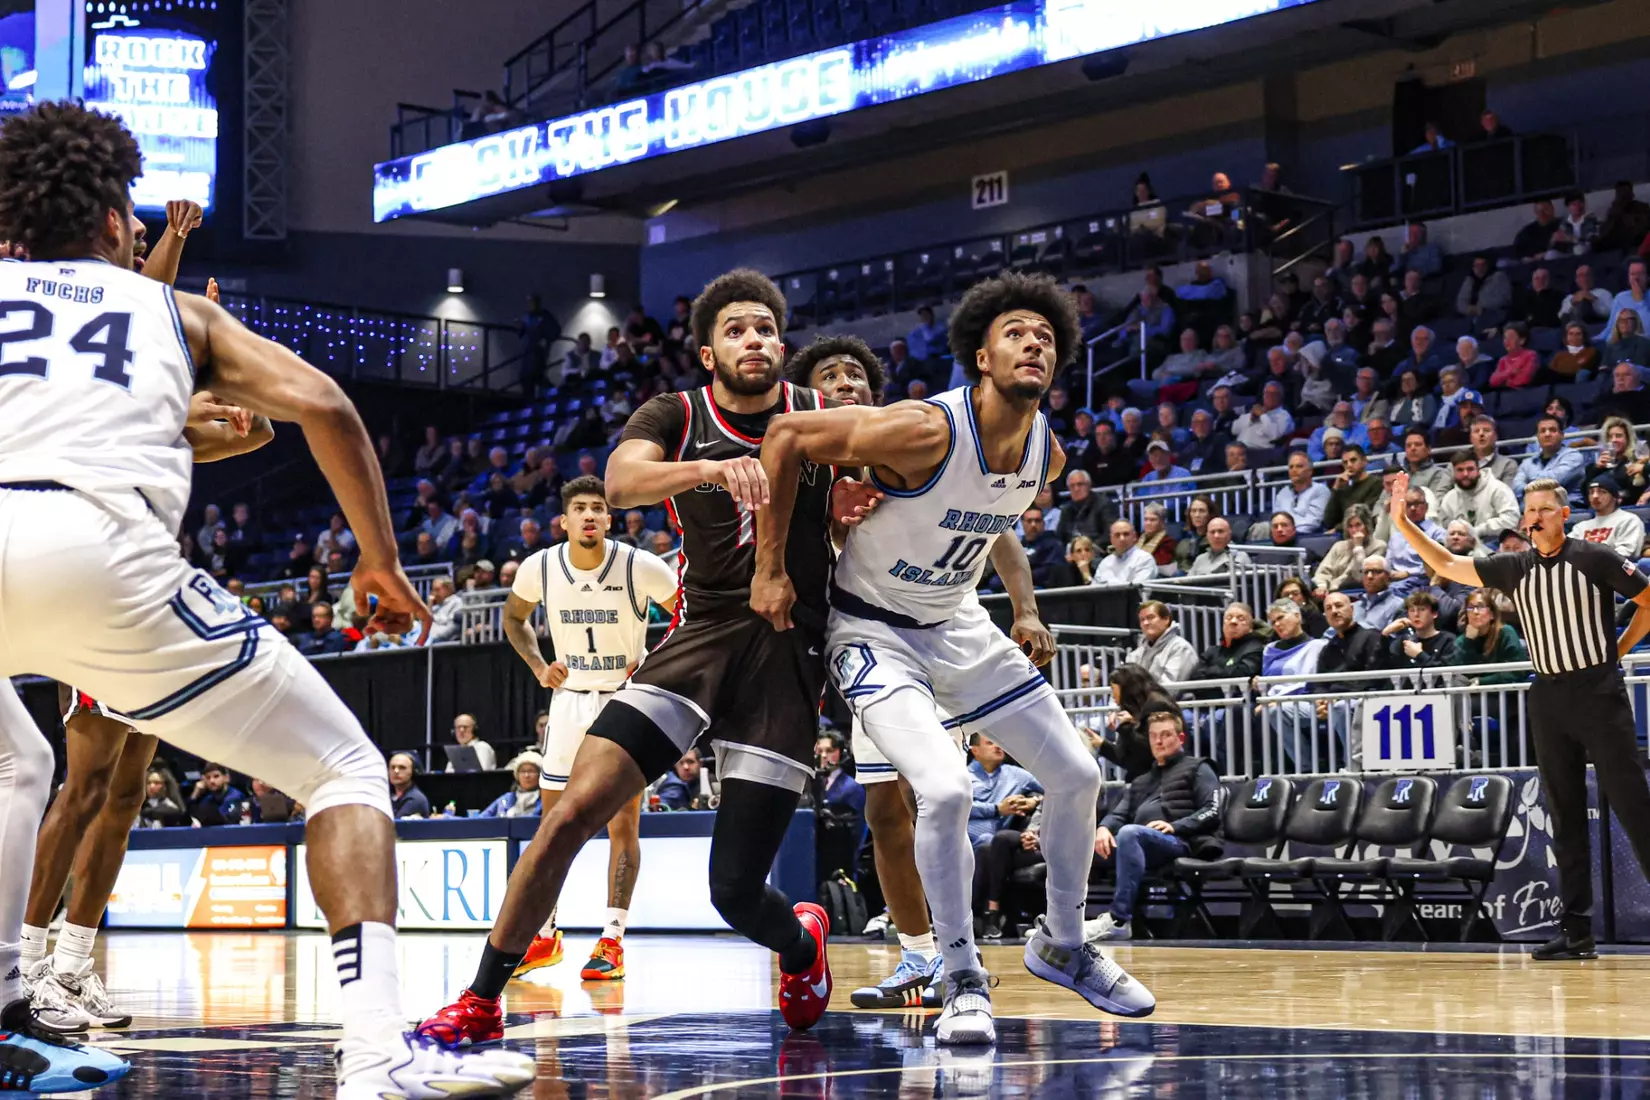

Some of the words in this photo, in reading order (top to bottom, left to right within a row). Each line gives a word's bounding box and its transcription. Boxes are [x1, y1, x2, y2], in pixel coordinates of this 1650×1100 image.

[411, 122, 539, 210] CK
[664, 49, 850, 149] HOUSE
[975, 175, 1003, 205] 211
[26, 277, 104, 304] FUCHS
[0, 299, 136, 393] 24
[932, 534, 988, 571] 10
[559, 609, 619, 624] RHODE
[585, 626, 597, 654] 1
[565, 654, 627, 671] ISLAND
[1372, 703, 1435, 760] 111
[1477, 894, 1506, 920] of
[1513, 880, 1565, 926] Fre
